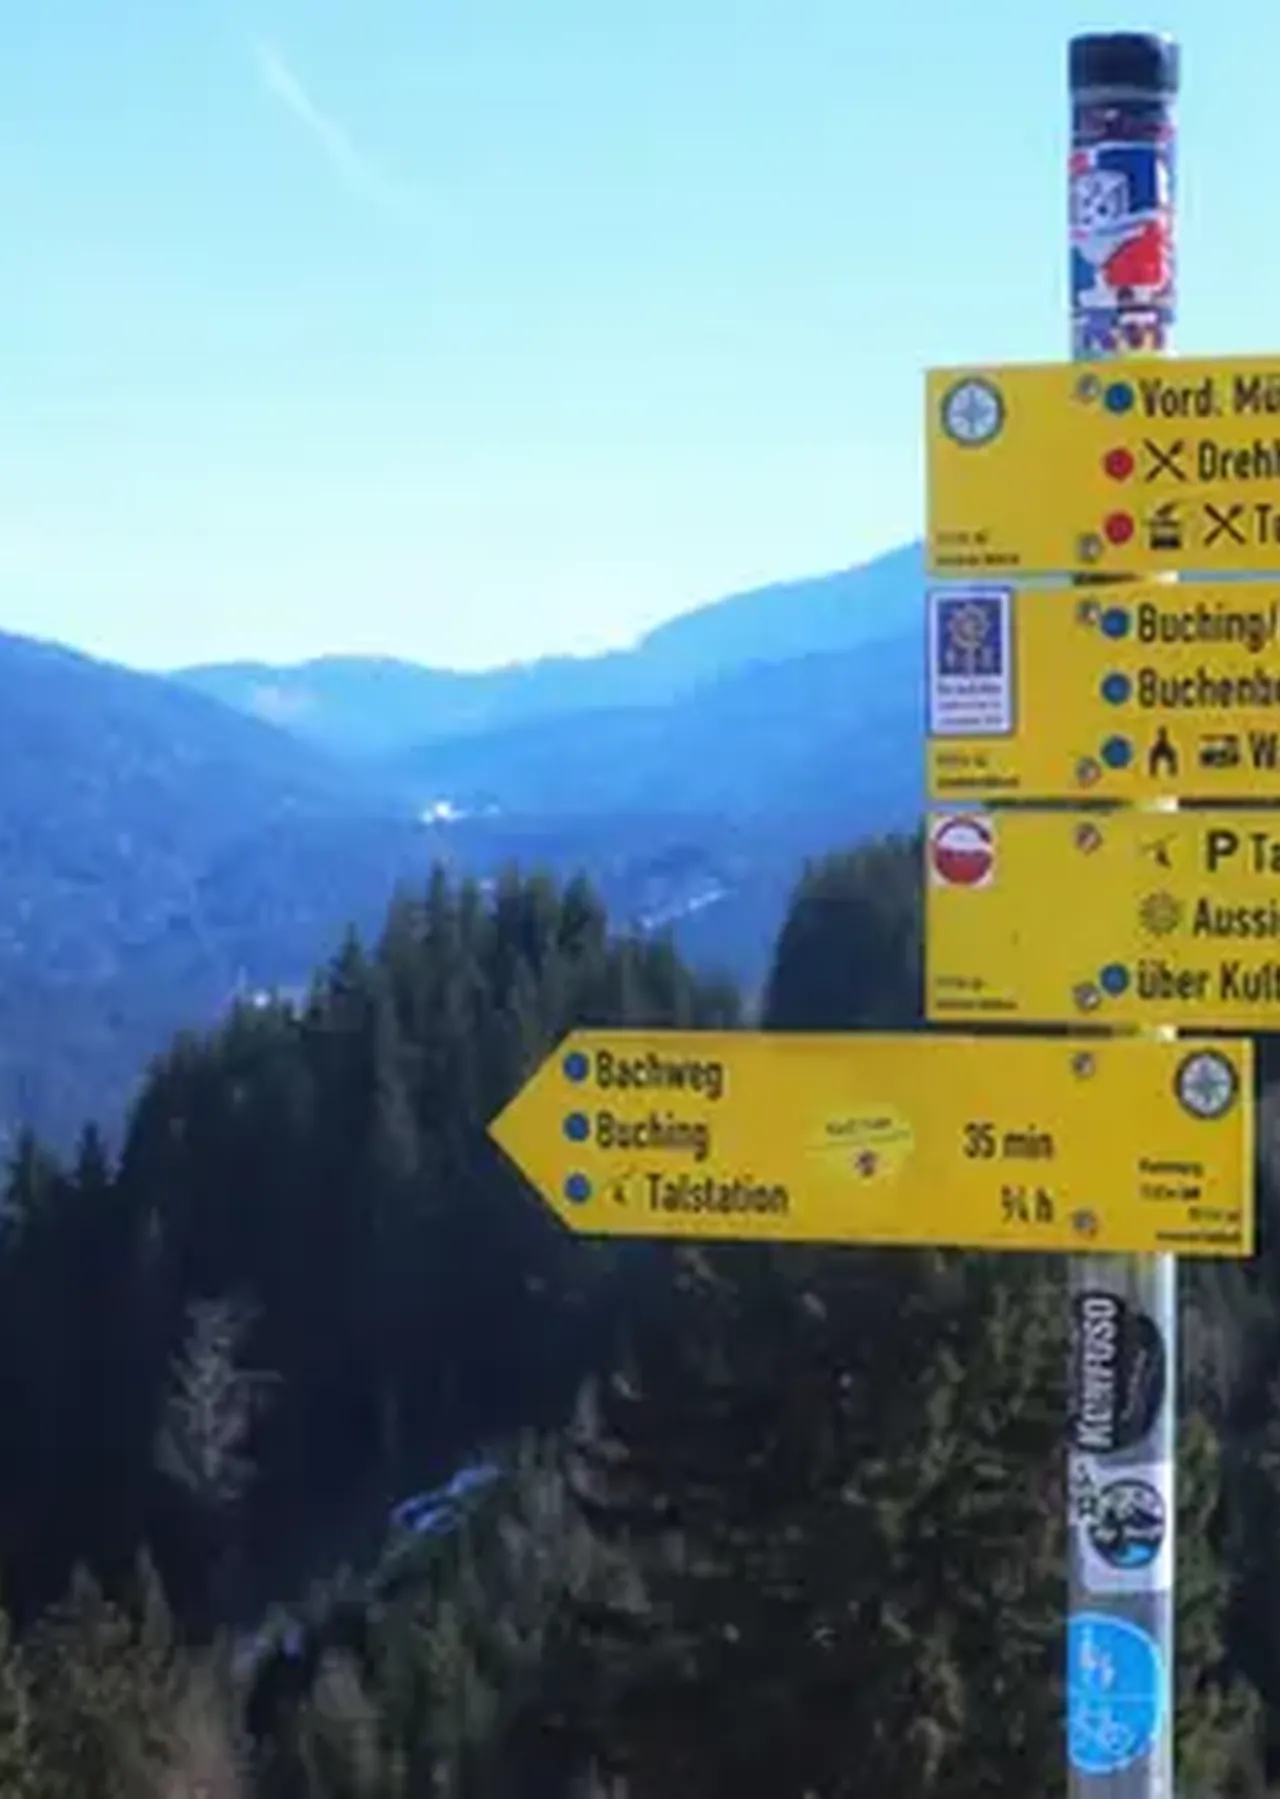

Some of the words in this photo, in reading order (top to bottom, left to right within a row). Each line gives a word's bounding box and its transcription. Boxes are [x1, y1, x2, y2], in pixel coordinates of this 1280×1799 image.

[1138, 377, 1222, 418] Vord.
[1206, 829, 1240, 873] P
[1136, 960, 1210, 1001] über
[595, 1049, 723, 1097] Bachweg
[595, 1113, 710, 1156] Buching
[964, 1122, 997, 1160] 35
[1002, 1124, 1054, 1159] min
[645, 1172, 789, 1215] Talstation
[1035, 1189, 1054, 1223] h
